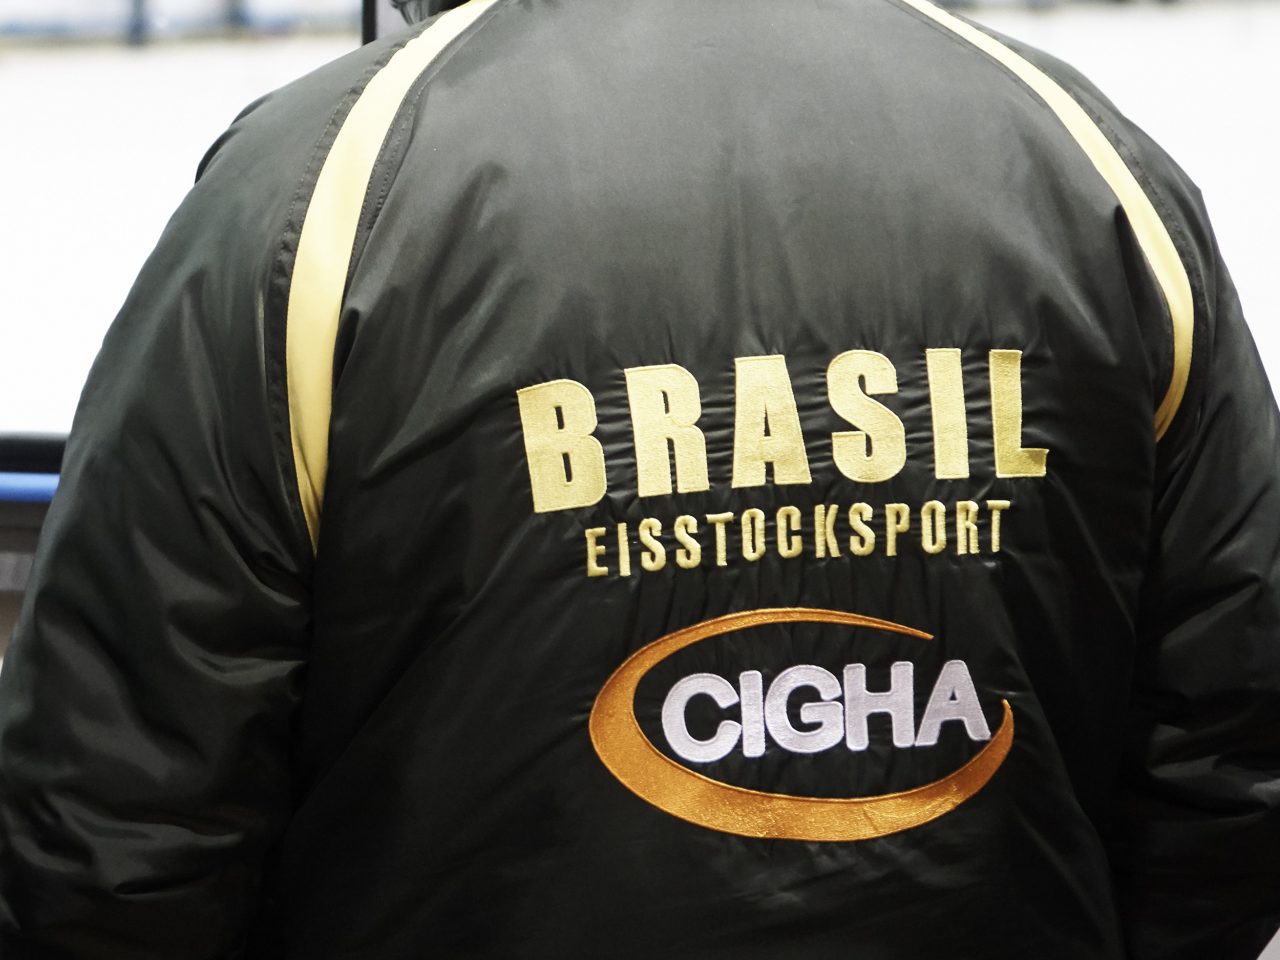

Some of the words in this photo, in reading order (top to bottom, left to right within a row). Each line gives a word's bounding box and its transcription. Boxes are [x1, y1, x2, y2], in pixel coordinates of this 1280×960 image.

[516, 348, 1050, 513] BRASIL
[585, 499, 1011, 577] EISSTOCKSPORT
[661, 659, 992, 764] CIGHA
